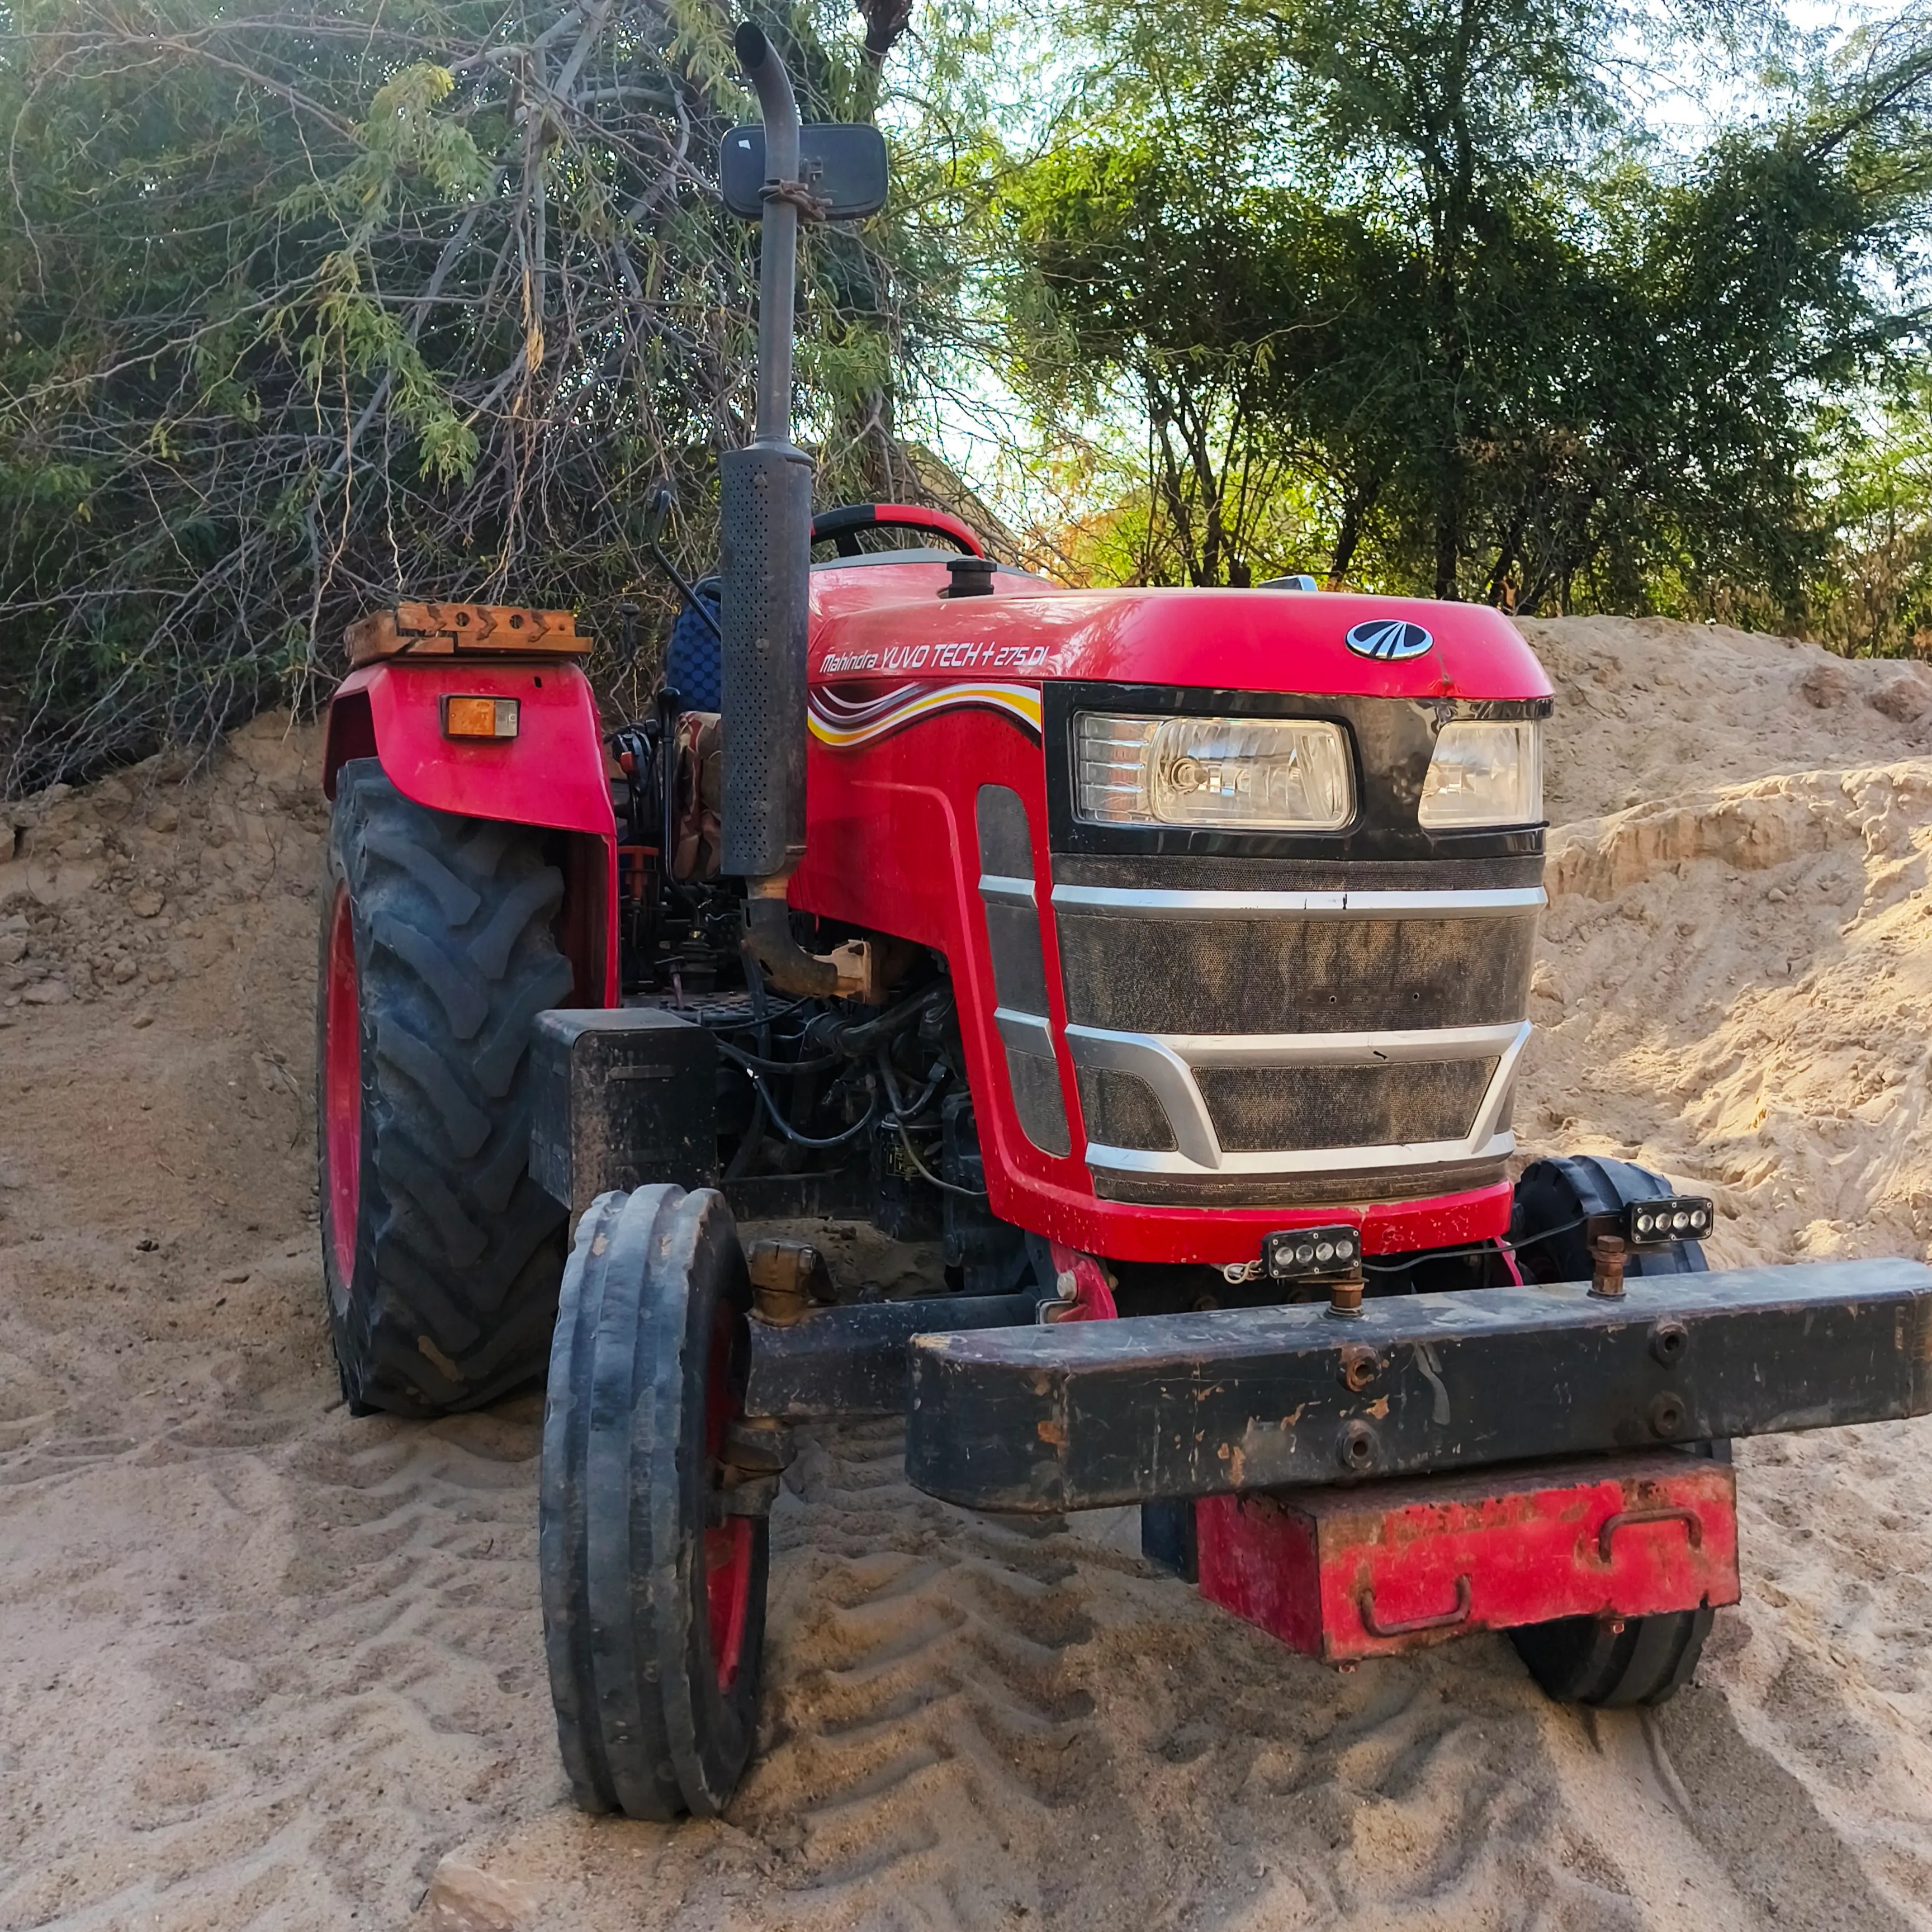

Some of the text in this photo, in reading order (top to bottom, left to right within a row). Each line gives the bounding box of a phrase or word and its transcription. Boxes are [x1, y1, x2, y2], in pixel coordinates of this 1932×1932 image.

[820, 651, 879, 673] Mahindra
[880, 645, 931, 669] YUVO
[994, 646, 1029, 666] 275
[1029, 646, 1050, 666] DI
